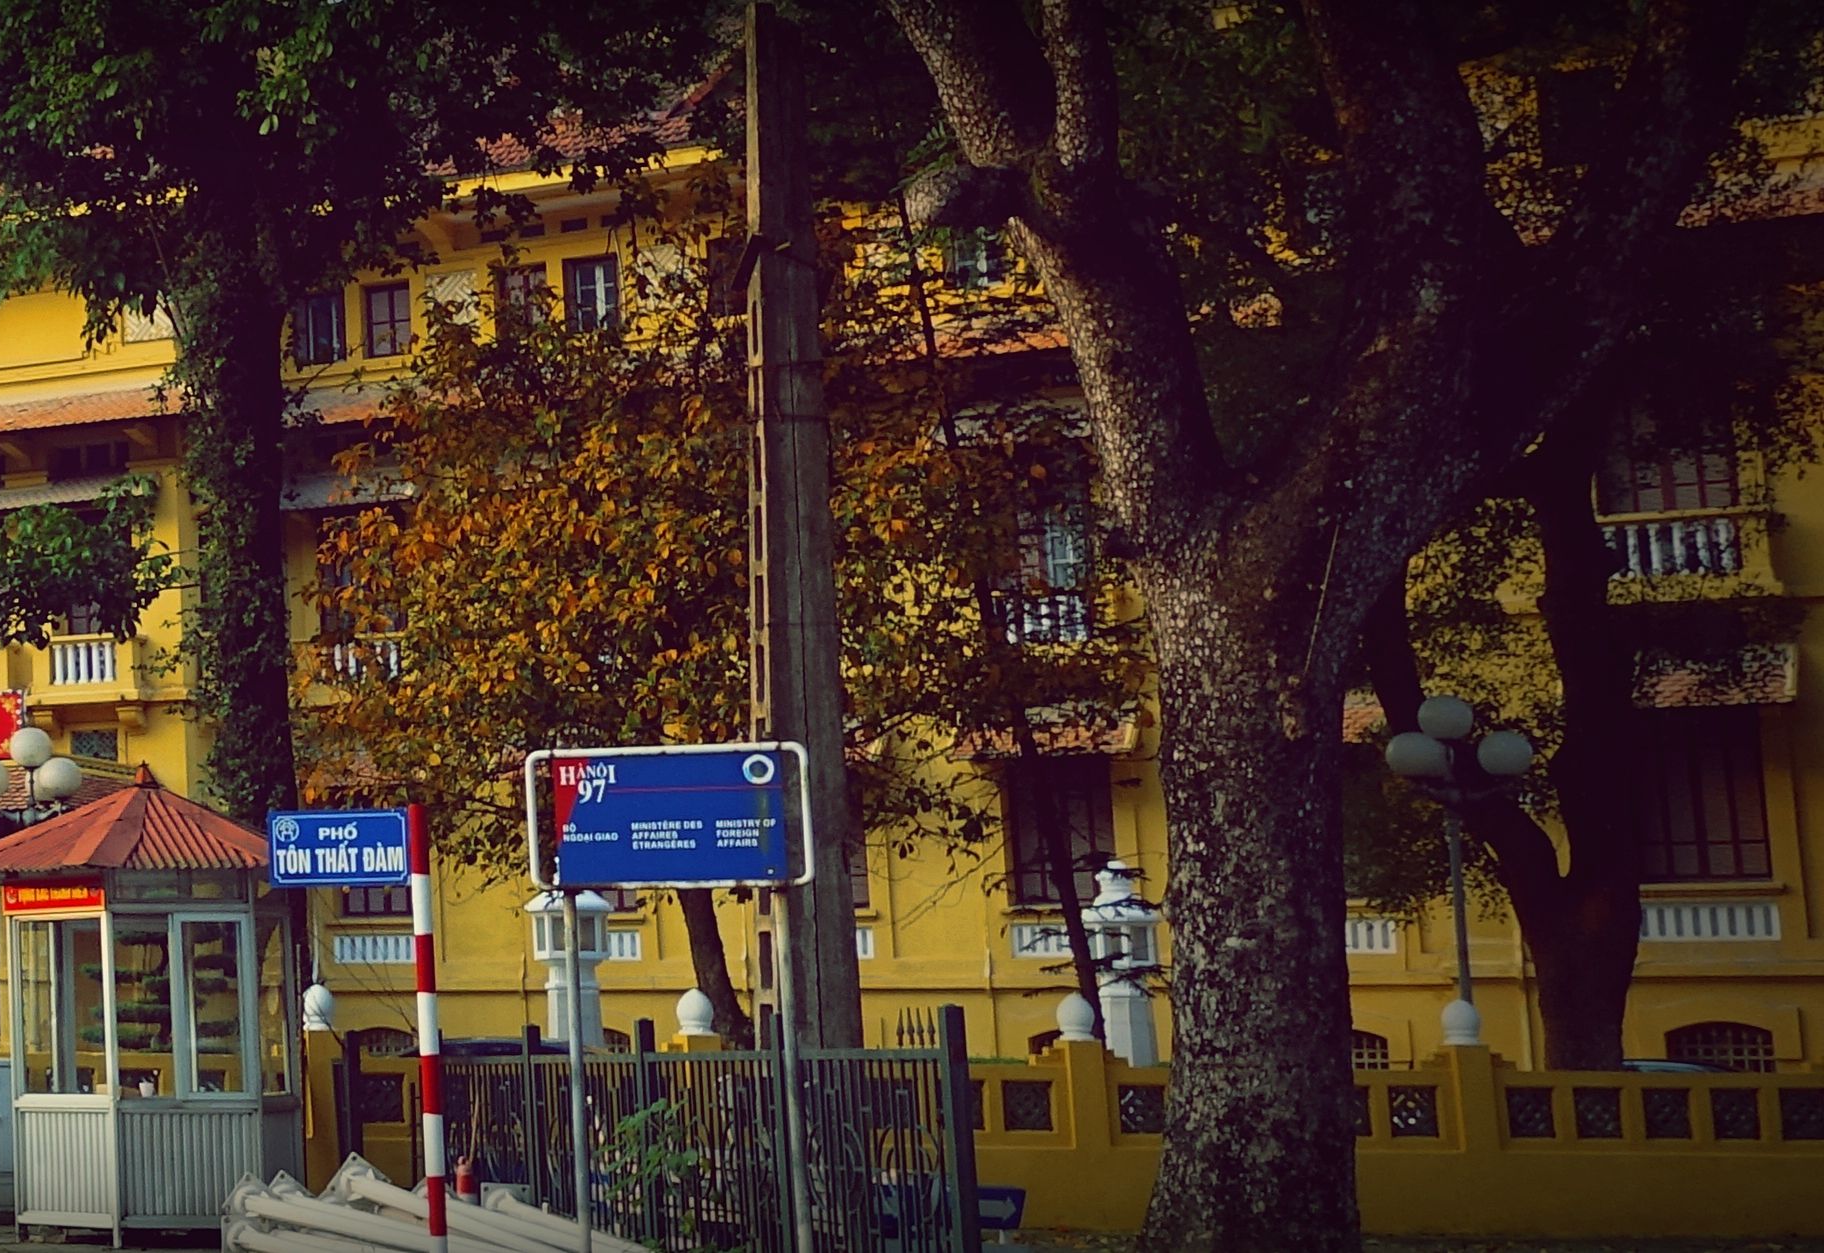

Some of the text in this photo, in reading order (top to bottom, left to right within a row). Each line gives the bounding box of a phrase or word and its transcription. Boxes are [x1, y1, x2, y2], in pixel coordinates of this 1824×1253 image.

[577, 779, 606, 804] 97
[683, 820, 703, 830] DES
[715, 818, 777, 828] MINISTRY OF
[318, 821, 358, 841] PHỐ
[631, 830, 678, 840] AFFAIRES
[716, 828, 760, 838] FOREIGN
[562, 832, 619, 844] NGOẠI GIAO
[716, 837, 758, 848] AFFAIRS
[276, 840, 404, 875] TÔN THẤT ĐÀM
